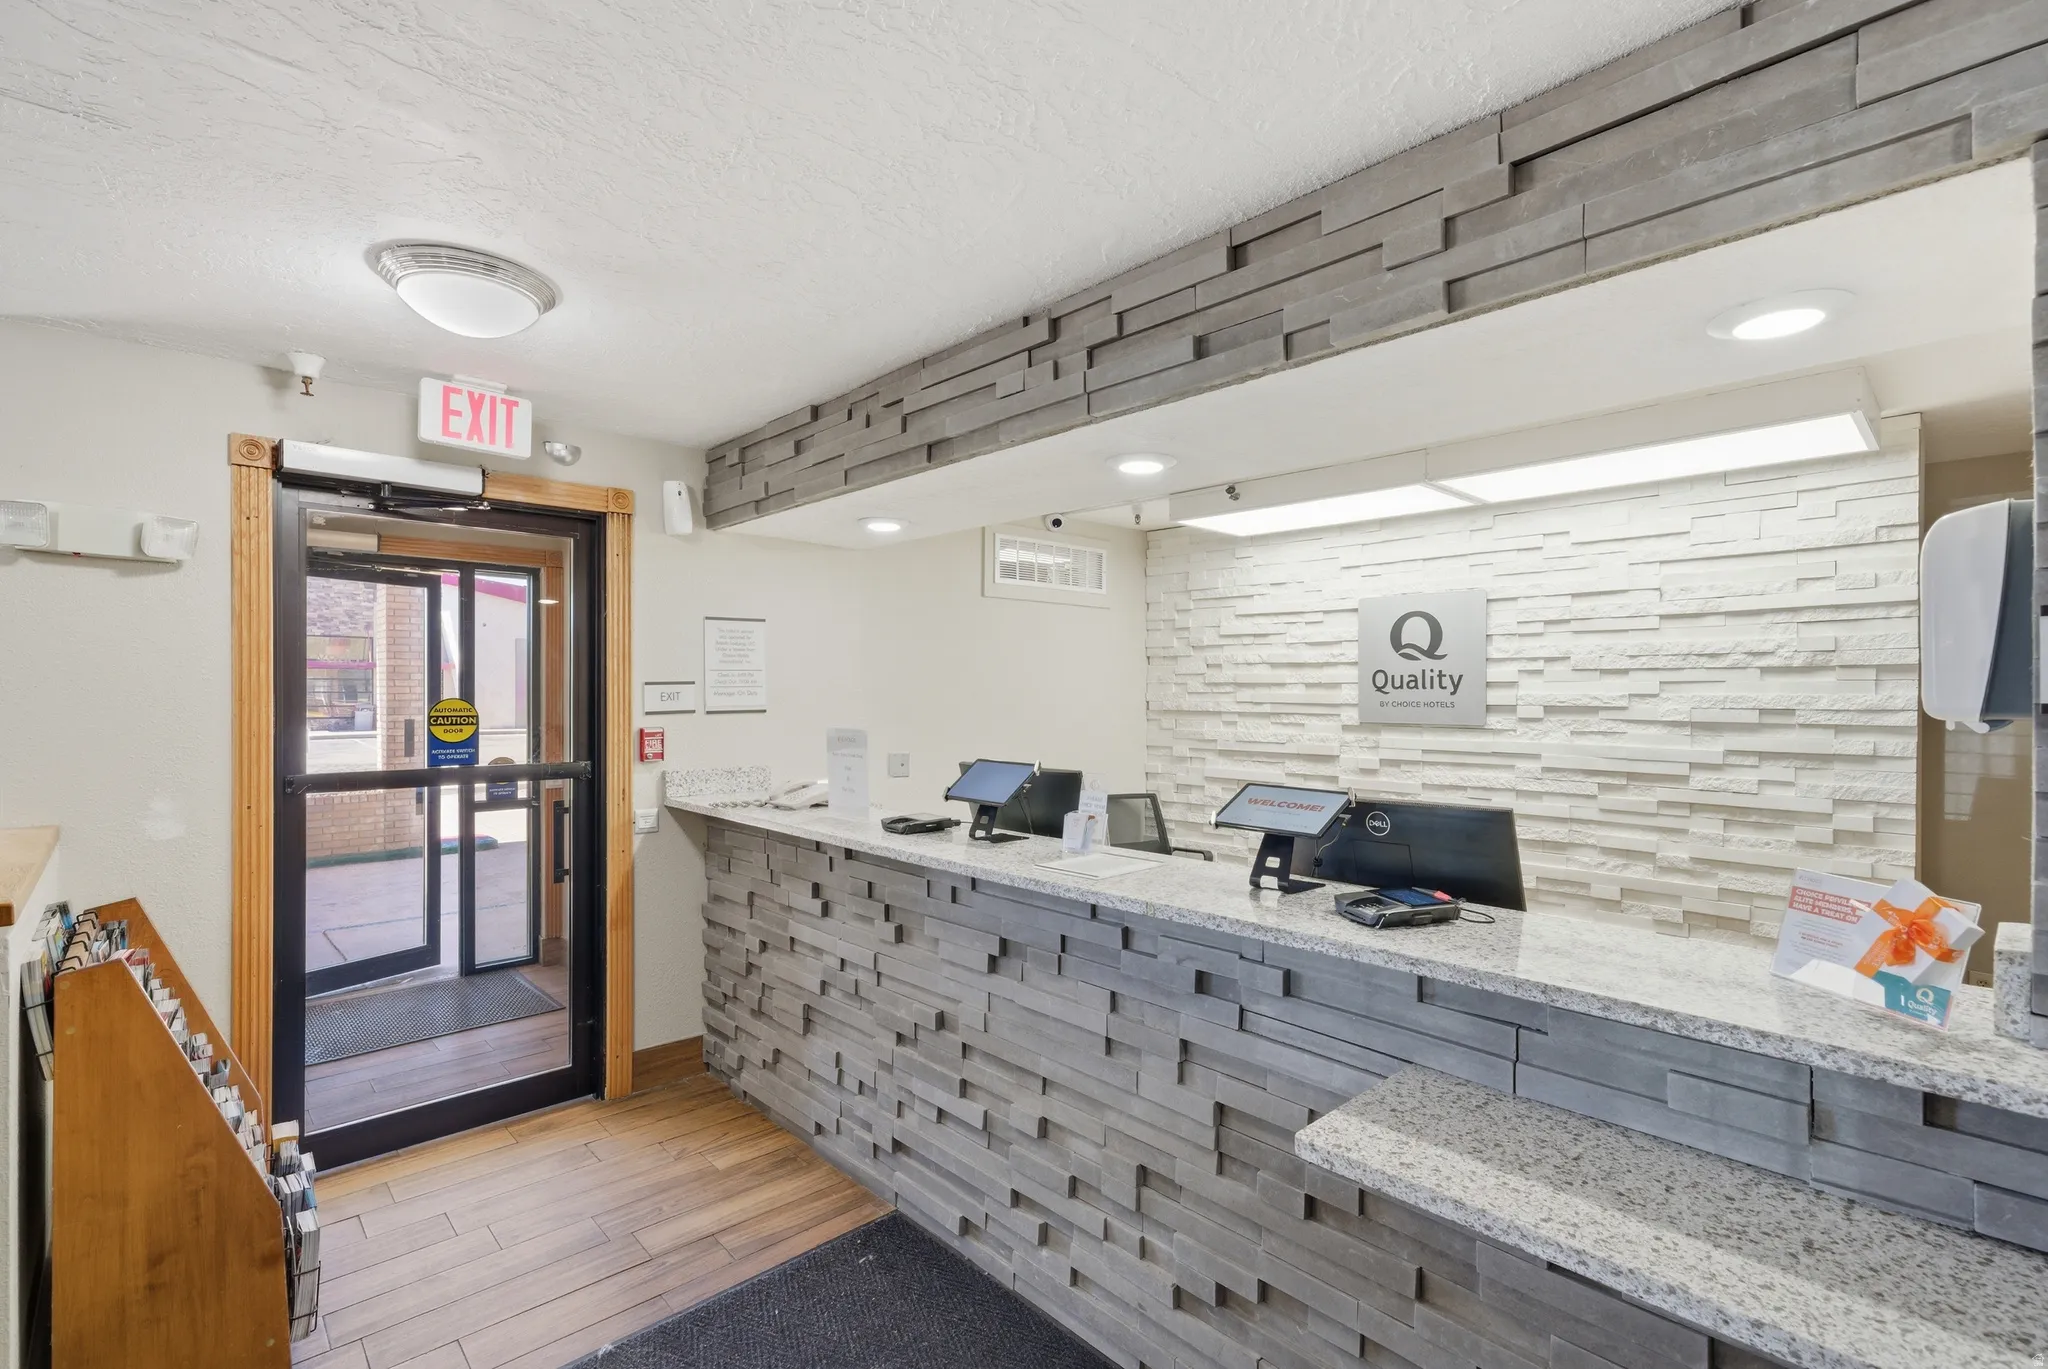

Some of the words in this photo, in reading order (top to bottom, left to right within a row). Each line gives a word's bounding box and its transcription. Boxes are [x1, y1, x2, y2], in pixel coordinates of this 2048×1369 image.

[441, 384, 520, 449] EXIT
[1389, 610, 1448, 661] Q
[1371, 668, 1464, 696] Quality
[660, 691, 681, 702] EXIT
[1379, 700, 1390, 708] BY
[1391, 700, 1421, 708] CHOICE
[1423, 701, 1455, 709] HOTELS
[430, 716, 477, 725] CAUTION
[1247, 796, 1326, 813] WELCOME!
[1368, 819, 1388, 828] DELL
[1793, 894, 1814, 905] ELITE
[1796, 888, 1824, 900] CHOICE
[1792, 902, 1813, 912] HAVE
[1821, 909, 1844, 919] TREAT
[1845, 914, 1859, 923] ON
[1907, 1000, 1938, 1016] Quality
